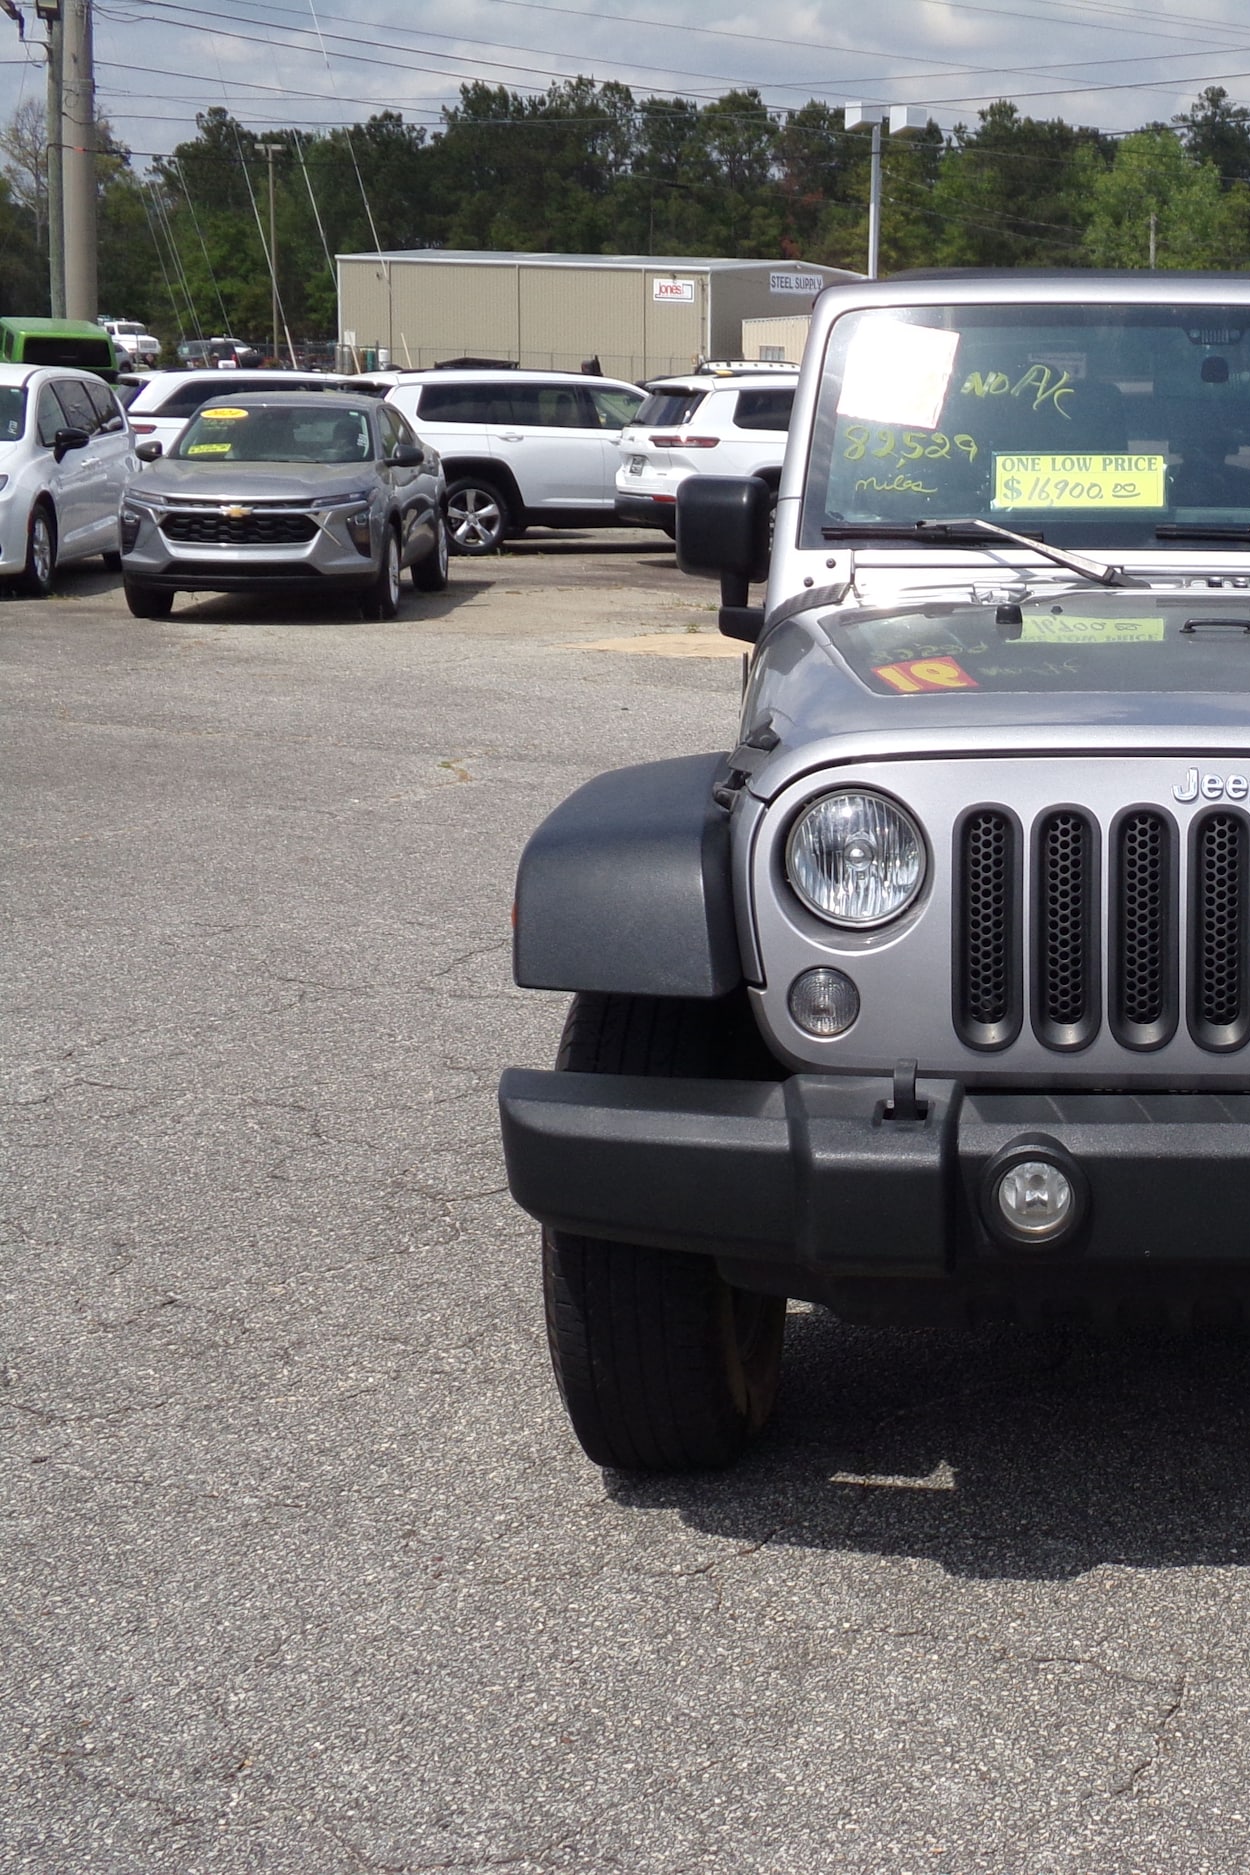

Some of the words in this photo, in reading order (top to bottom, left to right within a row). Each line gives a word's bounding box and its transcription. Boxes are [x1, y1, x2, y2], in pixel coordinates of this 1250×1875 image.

[770, 276, 793, 290] STEEL
[794, 277, 823, 291] SUPPLY
[960, 371, 1009, 398] NO
[1010, 364, 1075, 420] A/C
[1001, 457, 1041, 472] ONE
[1051, 457, 1092, 472] LOW
[1102, 456, 1158, 472] PRICE
[855, 474, 938, 493] miles
